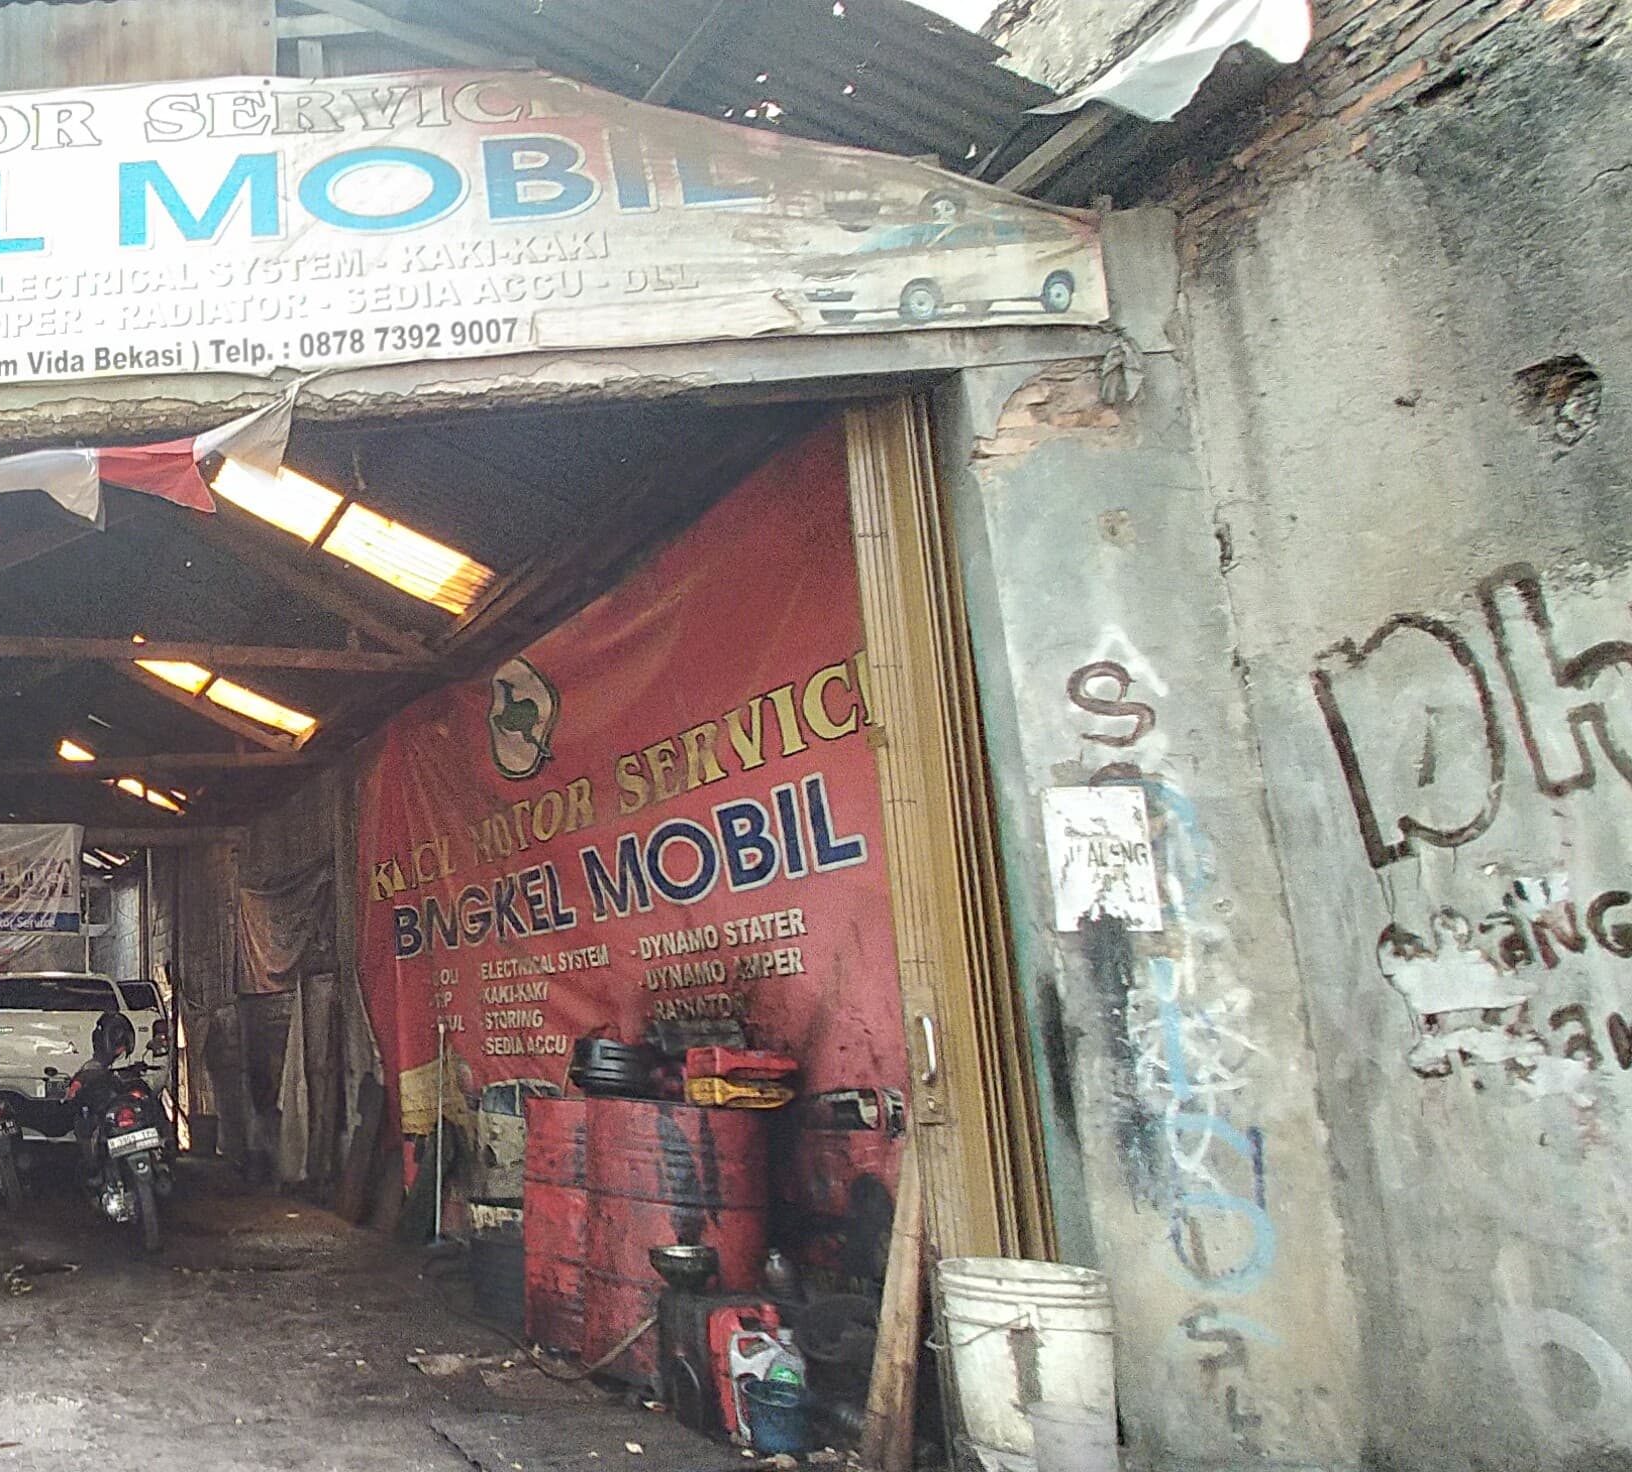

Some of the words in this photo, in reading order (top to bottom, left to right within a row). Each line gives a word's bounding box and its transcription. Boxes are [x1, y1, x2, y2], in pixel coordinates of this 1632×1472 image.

[118, 128, 773, 248] MOBIL
[209, 247, 365, 288] SYSTEM
[401, 231, 610, 273] KAKI-KAKI
[118, 293, 308, 331] RADIATOR
[347, 279, 462, 315] SEDIA
[472, 270, 585, 304] ACCU
[623, 265, 700, 294] DLL
[27, 349, 84, 375] Vida
[94, 342, 183, 371] Bekasi
[209, 337, 274, 366] Telp.
[299, 329, 365, 358] 0878
[374, 323, 442, 352] 7392
[451, 317, 518, 346] 9007
[394, 861, 577, 960] BNGKEL
[579, 771, 868, 923] MOBIL
[558, 944, 610, 972] SYSTEM
[639, 924, 718, 960] DYNAMO
[723, 907, 808, 947] STATER
[645, 959, 727, 990] DYNAMO
[484, 1009, 544, 1030] STORING
[485, 1036, 525, 1056] SEDIA
